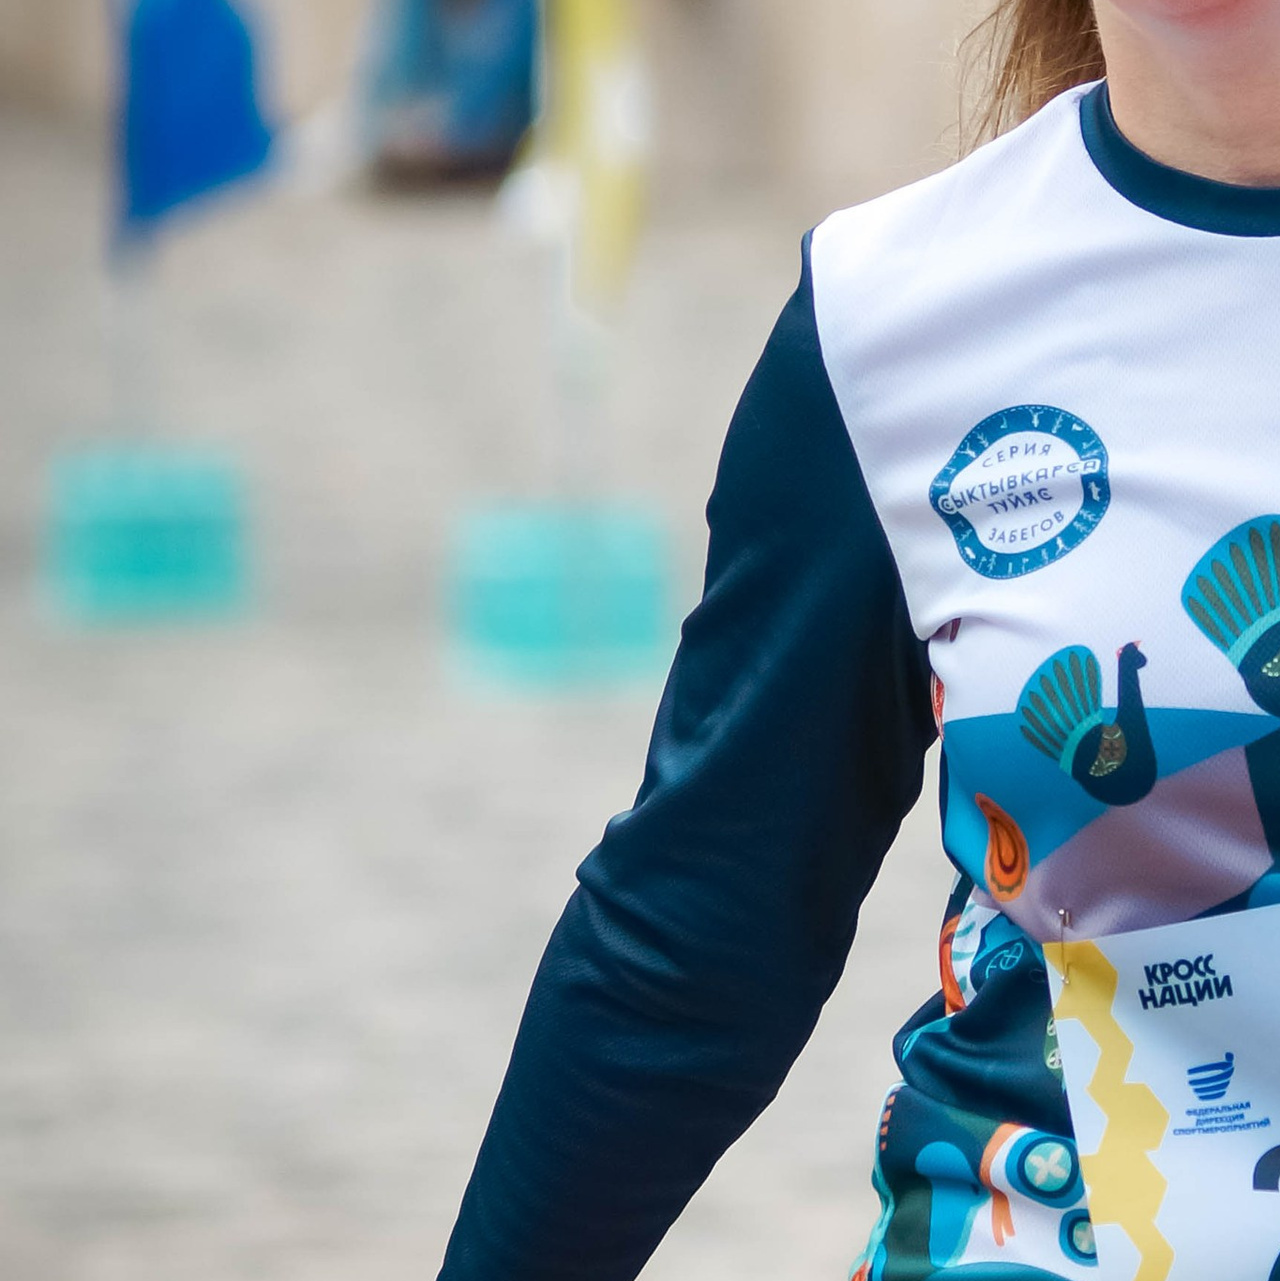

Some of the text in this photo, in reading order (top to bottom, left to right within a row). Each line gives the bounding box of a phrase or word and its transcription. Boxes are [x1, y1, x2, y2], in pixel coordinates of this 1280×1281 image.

[982, 442, 1052, 468] СЕРИЯ
[988, 510, 1065, 543] ЗАБЕГОВ
[1144, 953, 1216, 987] КРОСС
[1138, 974, 1233, 1010] НАЦИИ
